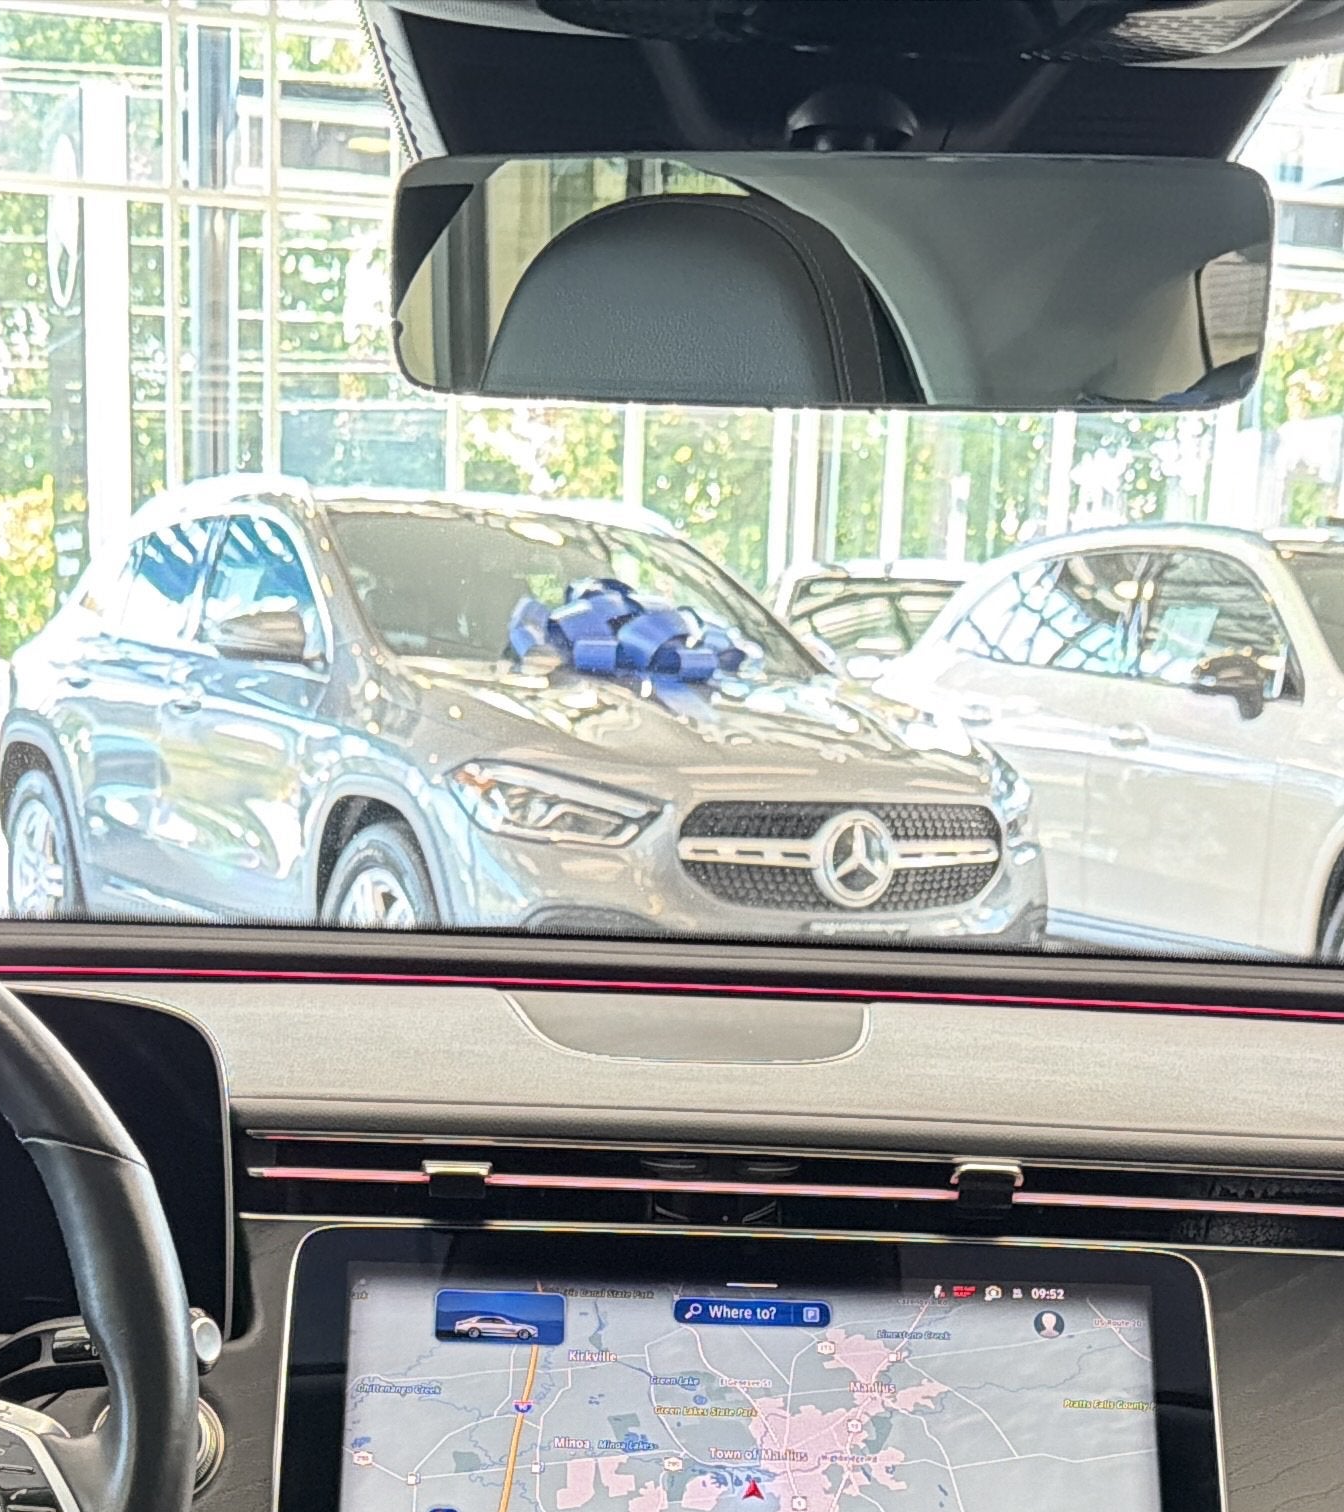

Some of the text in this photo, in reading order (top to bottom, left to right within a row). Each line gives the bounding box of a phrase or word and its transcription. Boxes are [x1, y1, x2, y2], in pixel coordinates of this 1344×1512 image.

[1031, 1288, 1065, 1300] 09:52
[709, 1304, 777, 1321] Where to?
[568, 1350, 618, 1362] Kirkville
[650, 1376, 700, 1386] Green Lake
[414, 1385, 442, 1395] Creek
[850, 1382, 896, 1394] Manlius
[1063, 1399, 1092, 1409] Pratts
[1093, 1400, 1115, 1410] Falls
[1116, 1401, 1149, 1412] County
[654, 1406, 760, 1418] Green Lakes State Park
[554, 1437, 590, 1449] Minoa
[598, 1440, 655, 1451] Minoa Lakes
[710, 1448, 809, 1462] Town of Manlius
